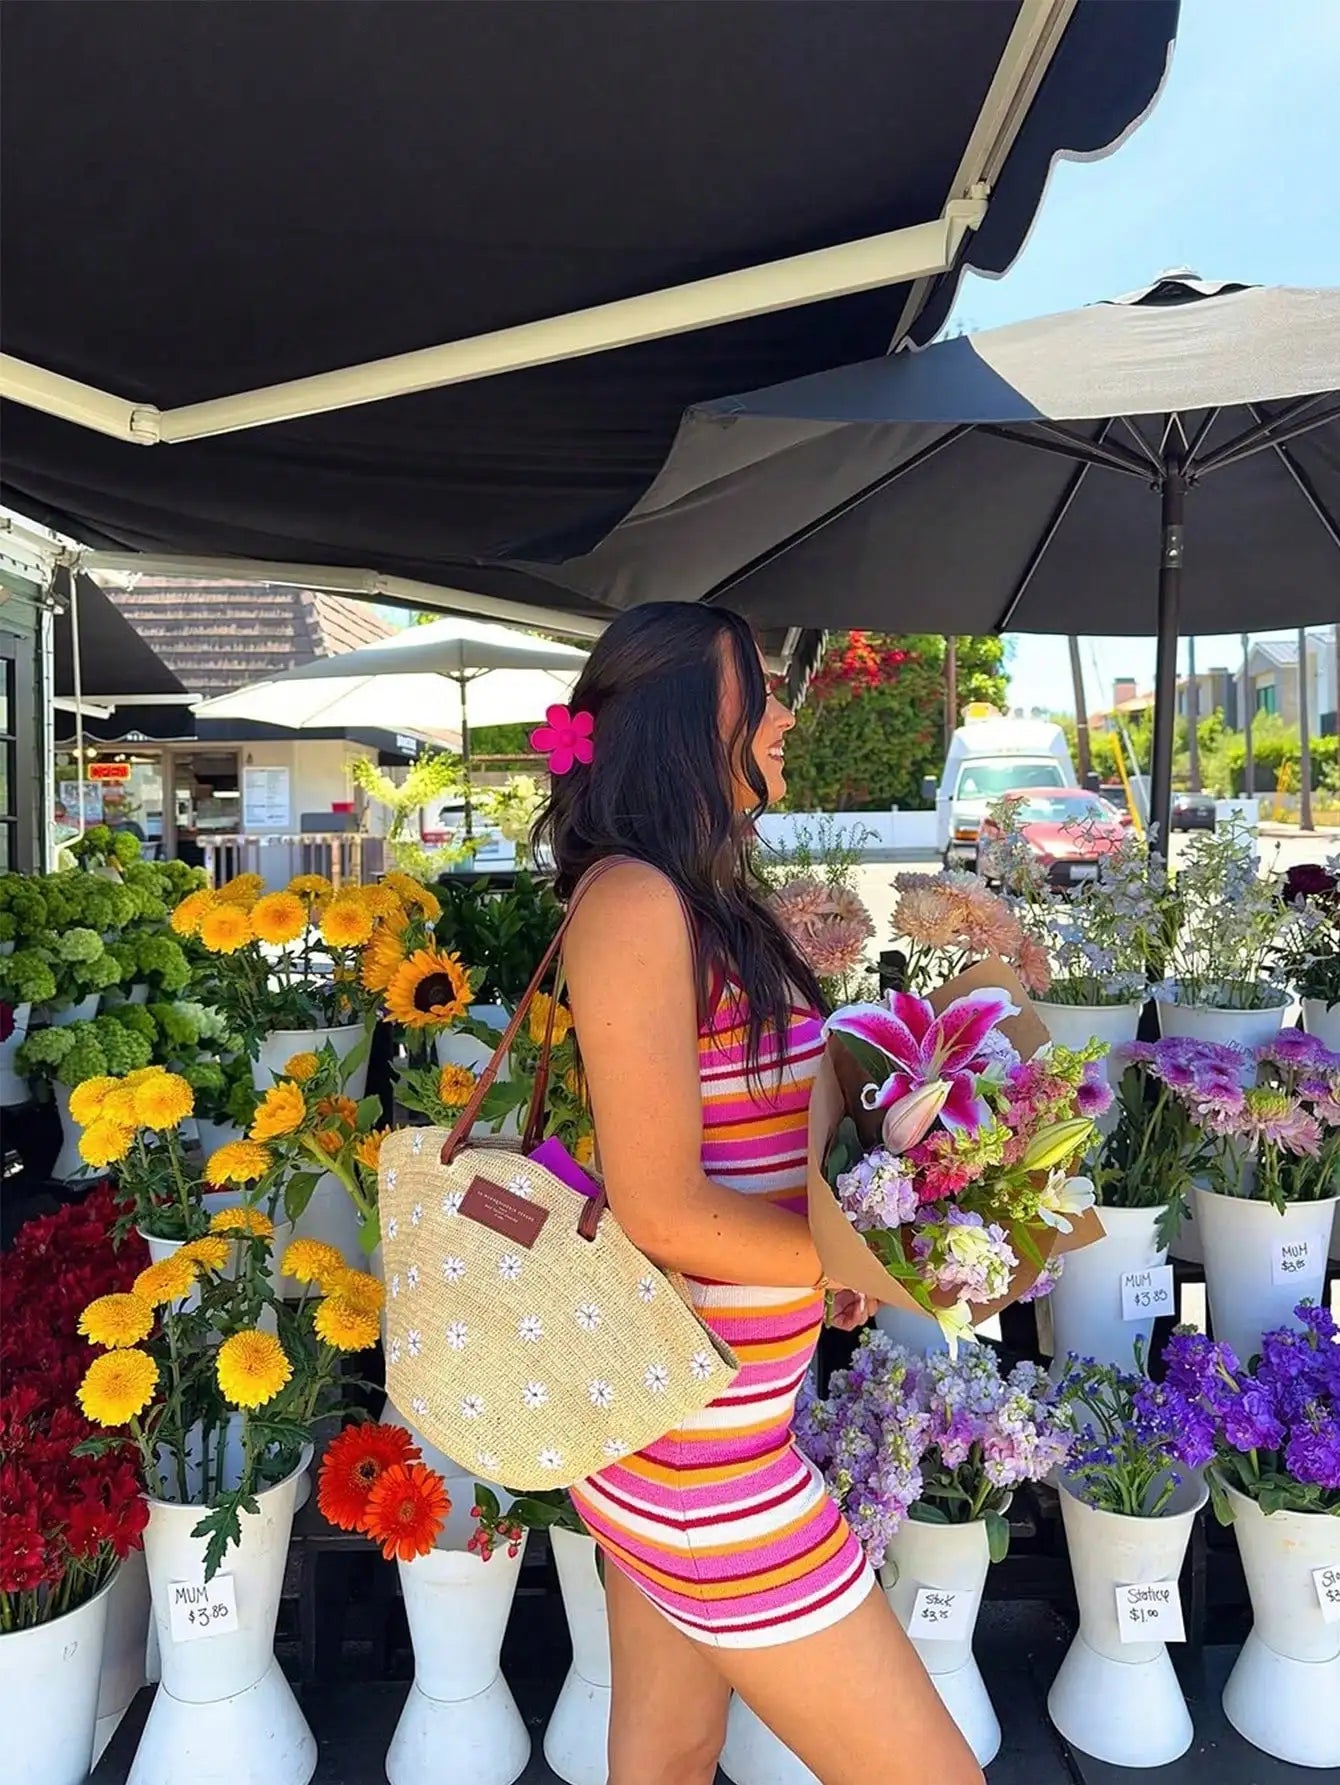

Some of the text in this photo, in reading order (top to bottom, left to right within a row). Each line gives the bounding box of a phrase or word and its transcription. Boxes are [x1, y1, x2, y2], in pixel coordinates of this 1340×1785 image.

[1280, 1242, 1308, 1258] MUM
[1125, 1271, 1152, 1288] MUM
[175, 1585, 209, 1604] MUM
[188, 1602, 229, 1627] $3.85
[1129, 1607, 1159, 1623] $1.00
